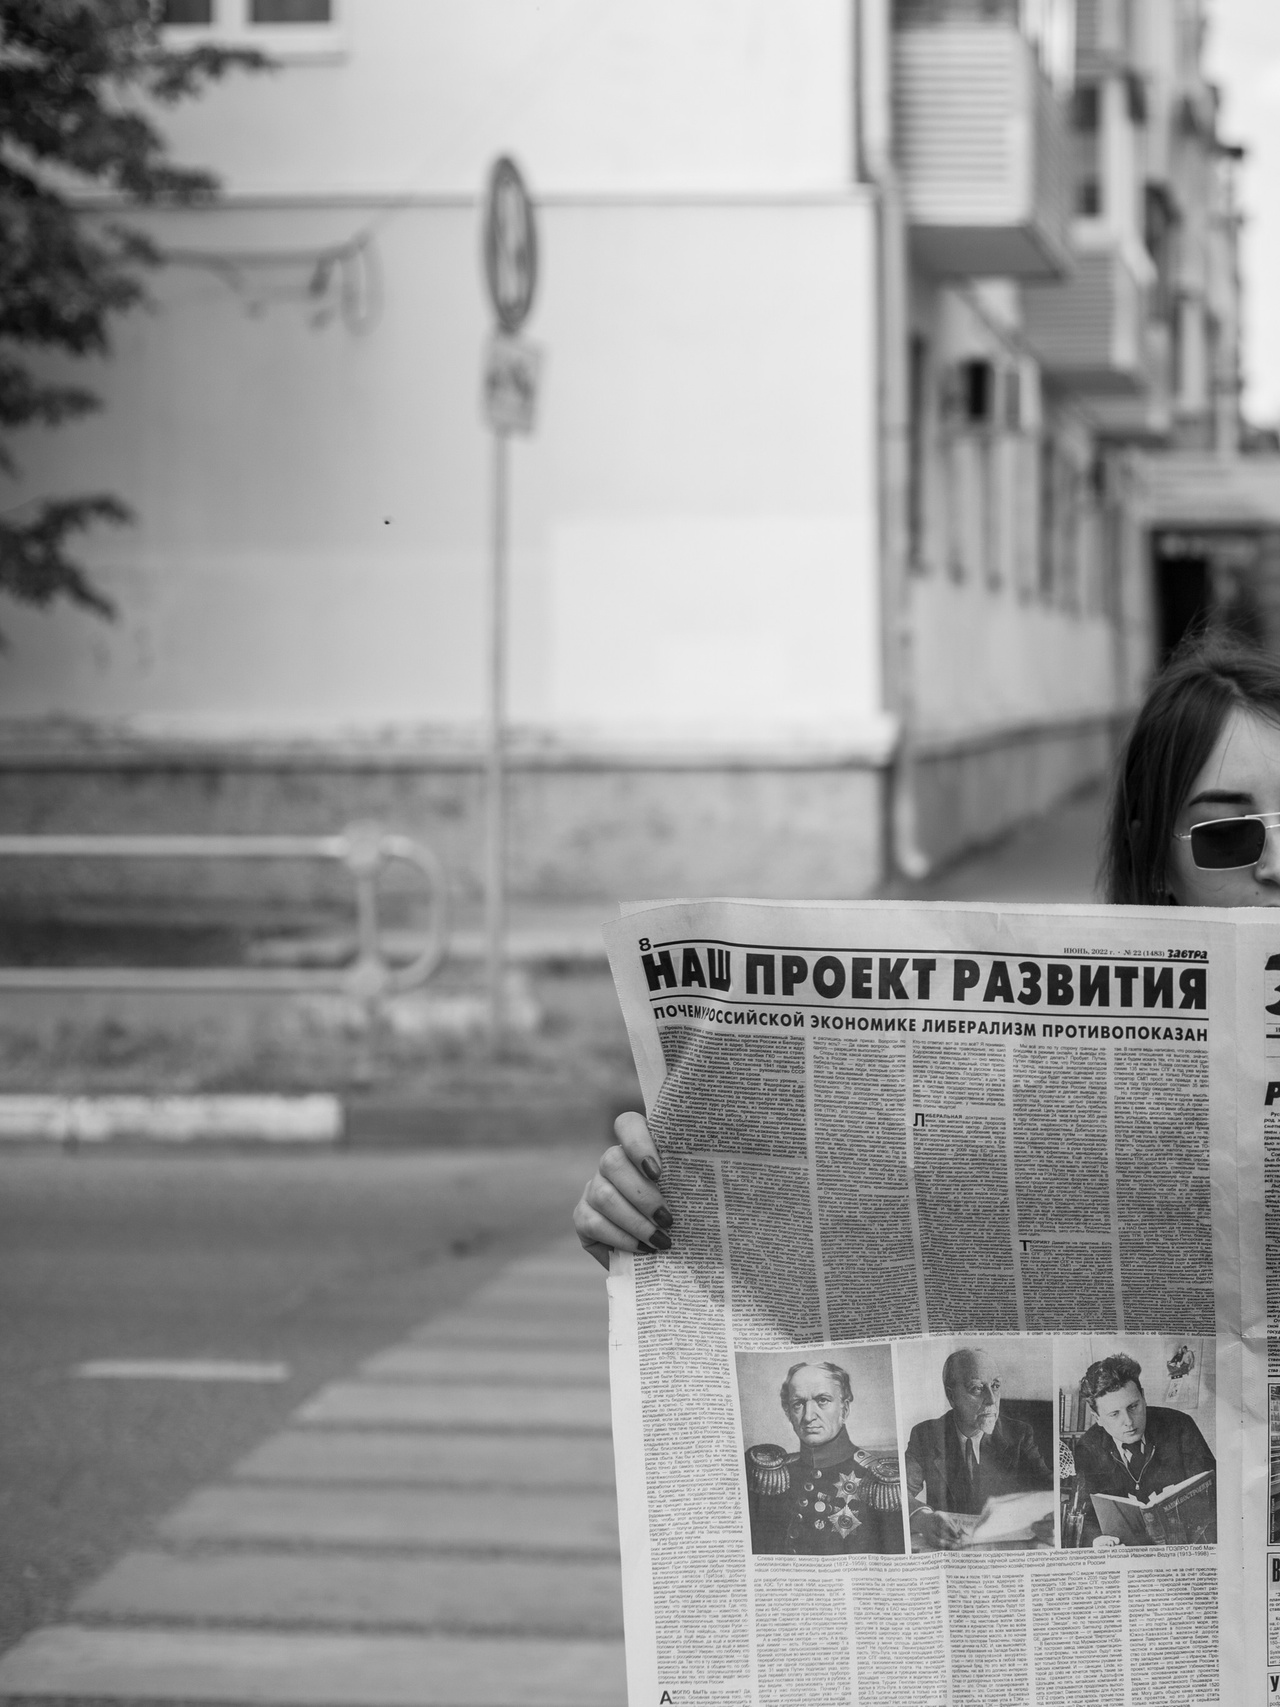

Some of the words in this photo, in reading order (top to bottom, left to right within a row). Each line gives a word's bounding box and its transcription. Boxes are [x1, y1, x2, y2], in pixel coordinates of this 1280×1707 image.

[639, 938, 652, 952] 8
[1091, 948, 1108, 956] 2022
[1143, 950, 1165, 958] (1483)
[641, 948, 731, 992] НАШ
[746, 953, 936, 1000] ПРОЕКТ
[952, 958, 1207, 1010] РАЗВИТИЯ
[810, 1014, 916, 1032] ЭКОНОМИКЕ
[922, 1020, 1036, 1037] ЛИБЕРАЛИЗМ
[1042, 1024, 1208, 1042] ПРОТИВОПОКАЗАН
